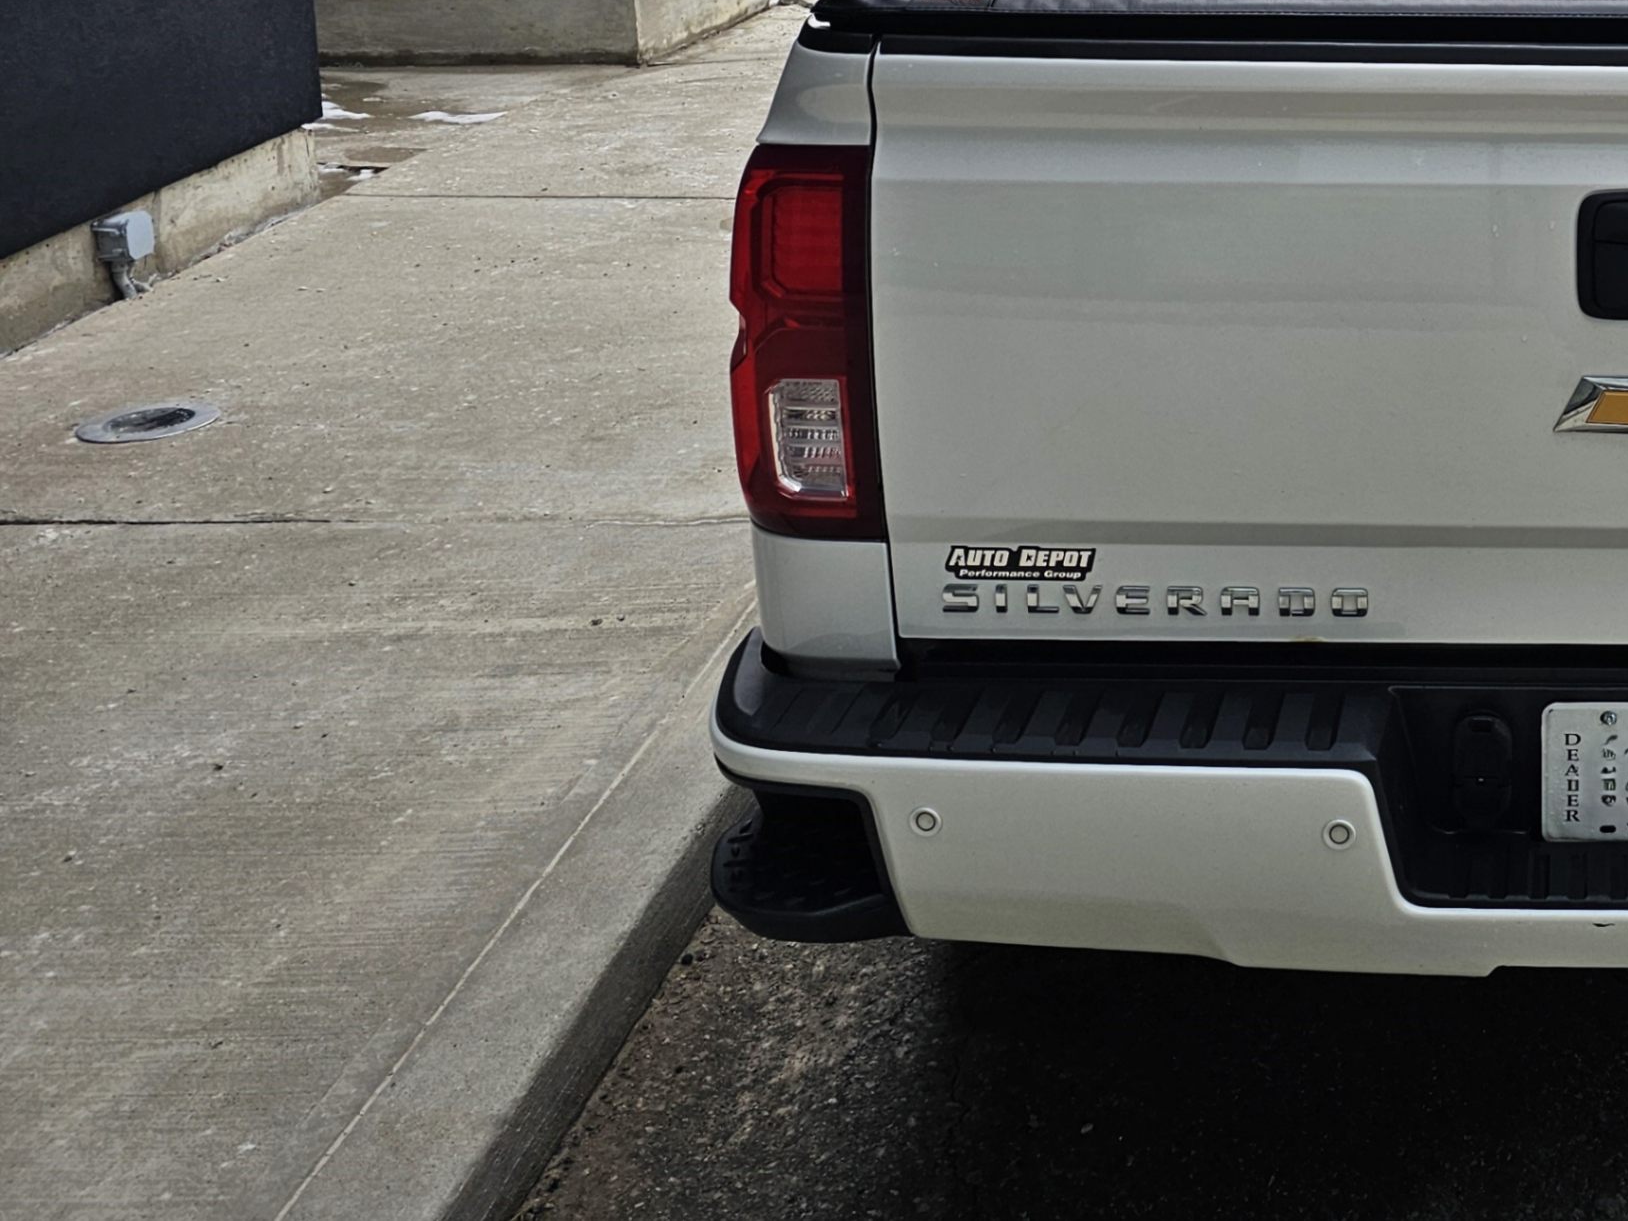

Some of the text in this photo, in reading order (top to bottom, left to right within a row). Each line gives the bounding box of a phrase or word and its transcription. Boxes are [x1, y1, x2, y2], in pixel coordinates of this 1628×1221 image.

[949, 548, 1092, 567] AUTO DEPOT
[959, 569, 1082, 580] Performance Group
[942, 584, 1370, 618] SILVERADO
